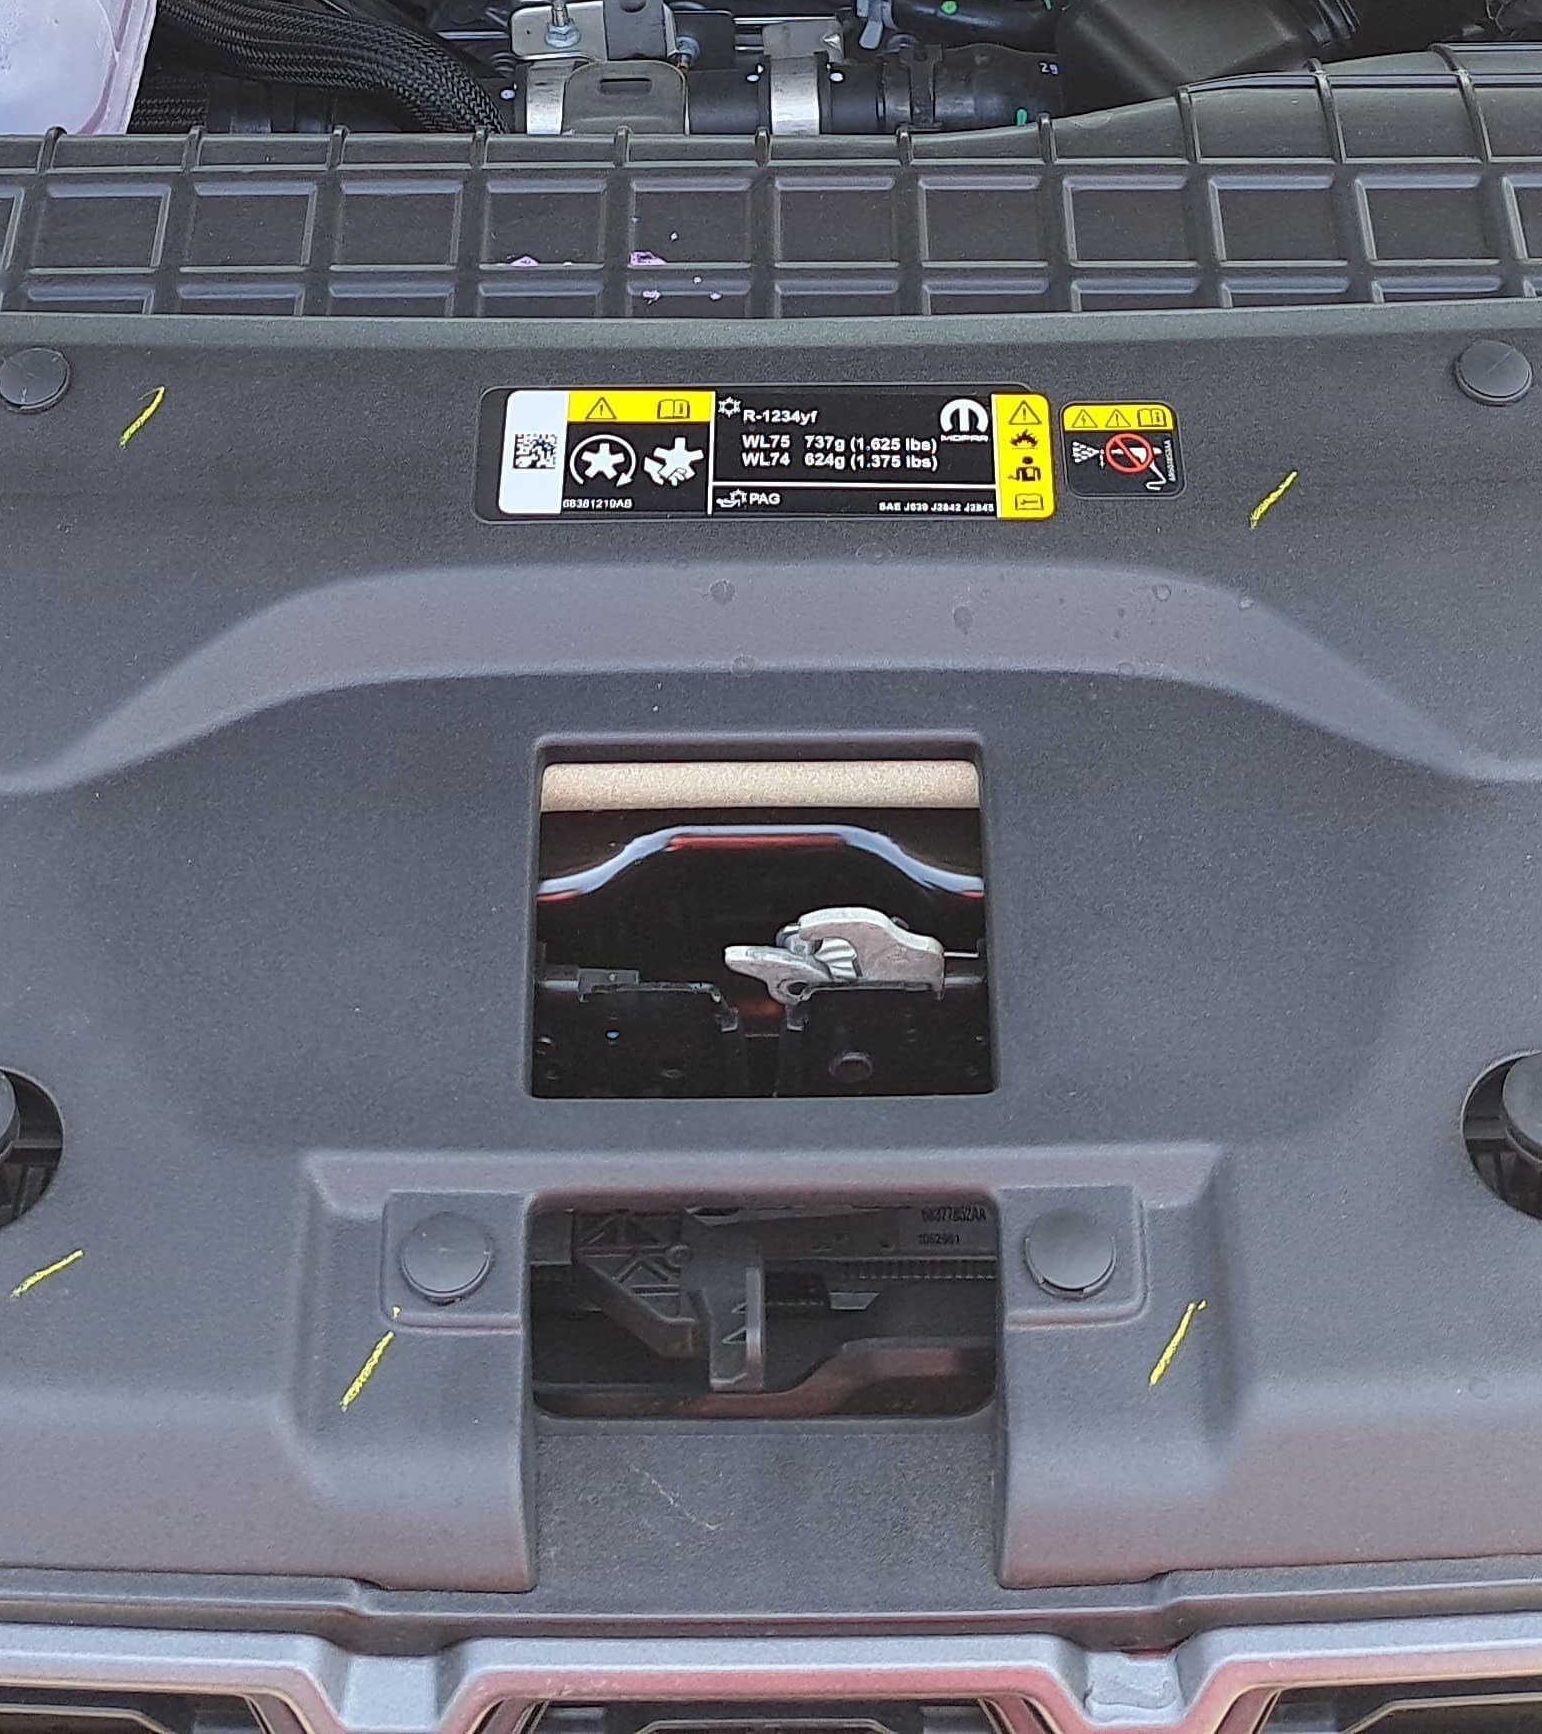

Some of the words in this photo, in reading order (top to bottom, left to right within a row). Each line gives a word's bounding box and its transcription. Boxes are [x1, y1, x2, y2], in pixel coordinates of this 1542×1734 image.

[743, 409, 818, 426] R-1234yf
[741, 434, 791, 449] WL75
[804, 435, 846, 452] 737g
[905, 437, 937, 455] lbs)
[741, 452, 791, 467] WL74
[804, 453, 846, 470] 624g
[850, 454, 901, 471] (1.375
[905, 455, 938, 472] lbs)
[749, 493, 781, 505] PAG
[878, 501, 902, 512] SAE
